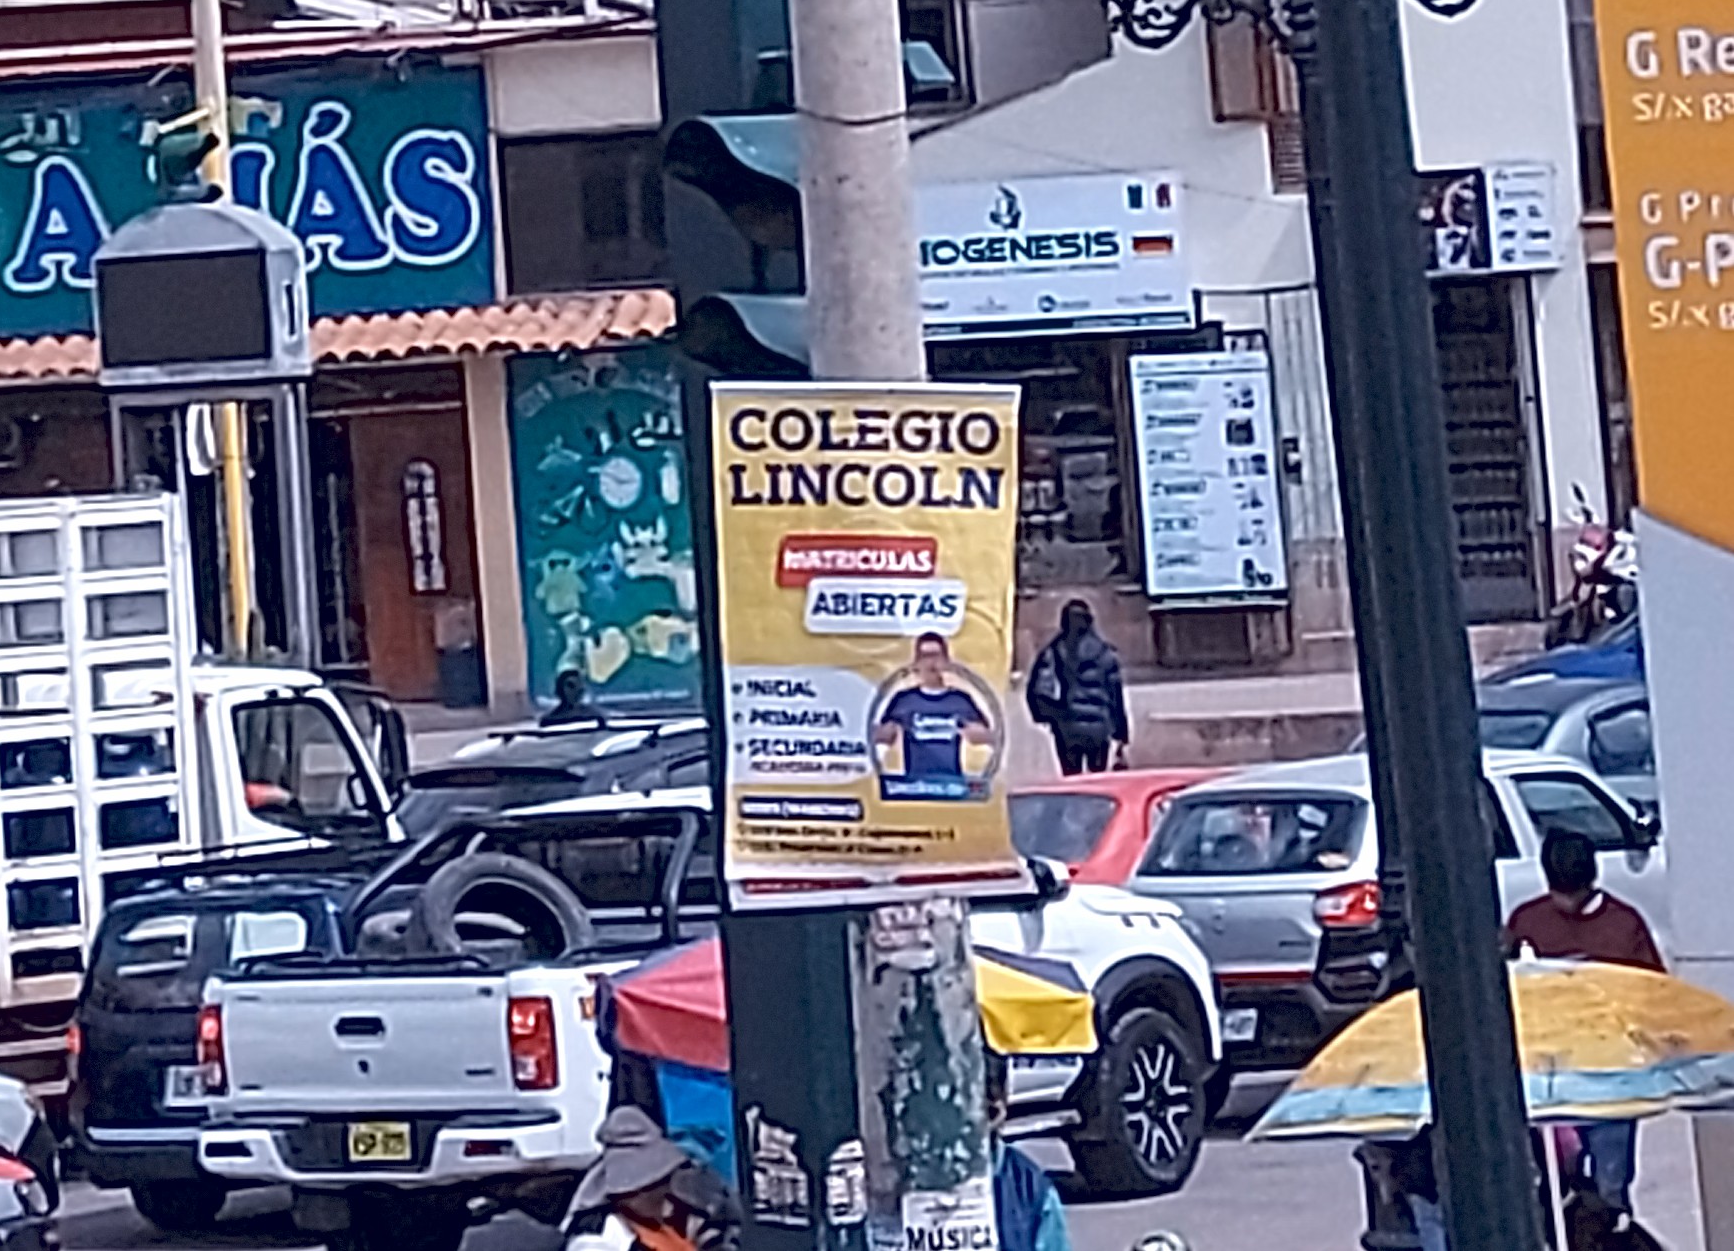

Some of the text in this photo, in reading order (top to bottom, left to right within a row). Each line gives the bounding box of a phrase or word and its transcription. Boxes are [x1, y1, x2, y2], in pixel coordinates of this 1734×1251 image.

[1627, 28, 1734, 79] G Re
[3, 155, 112, 292] A
[147, 101, 480, 272] ÁS
[1640, 192, 1662, 225] G
[919, 231, 1120, 267] IOGENESIS
[1645, 232, 1734, 289] G-P
[730, 408, 1000, 456] COLEGIO
[729, 464, 1005, 509] LINCOLN
[812, 592, 958, 618] ABIERTAS
